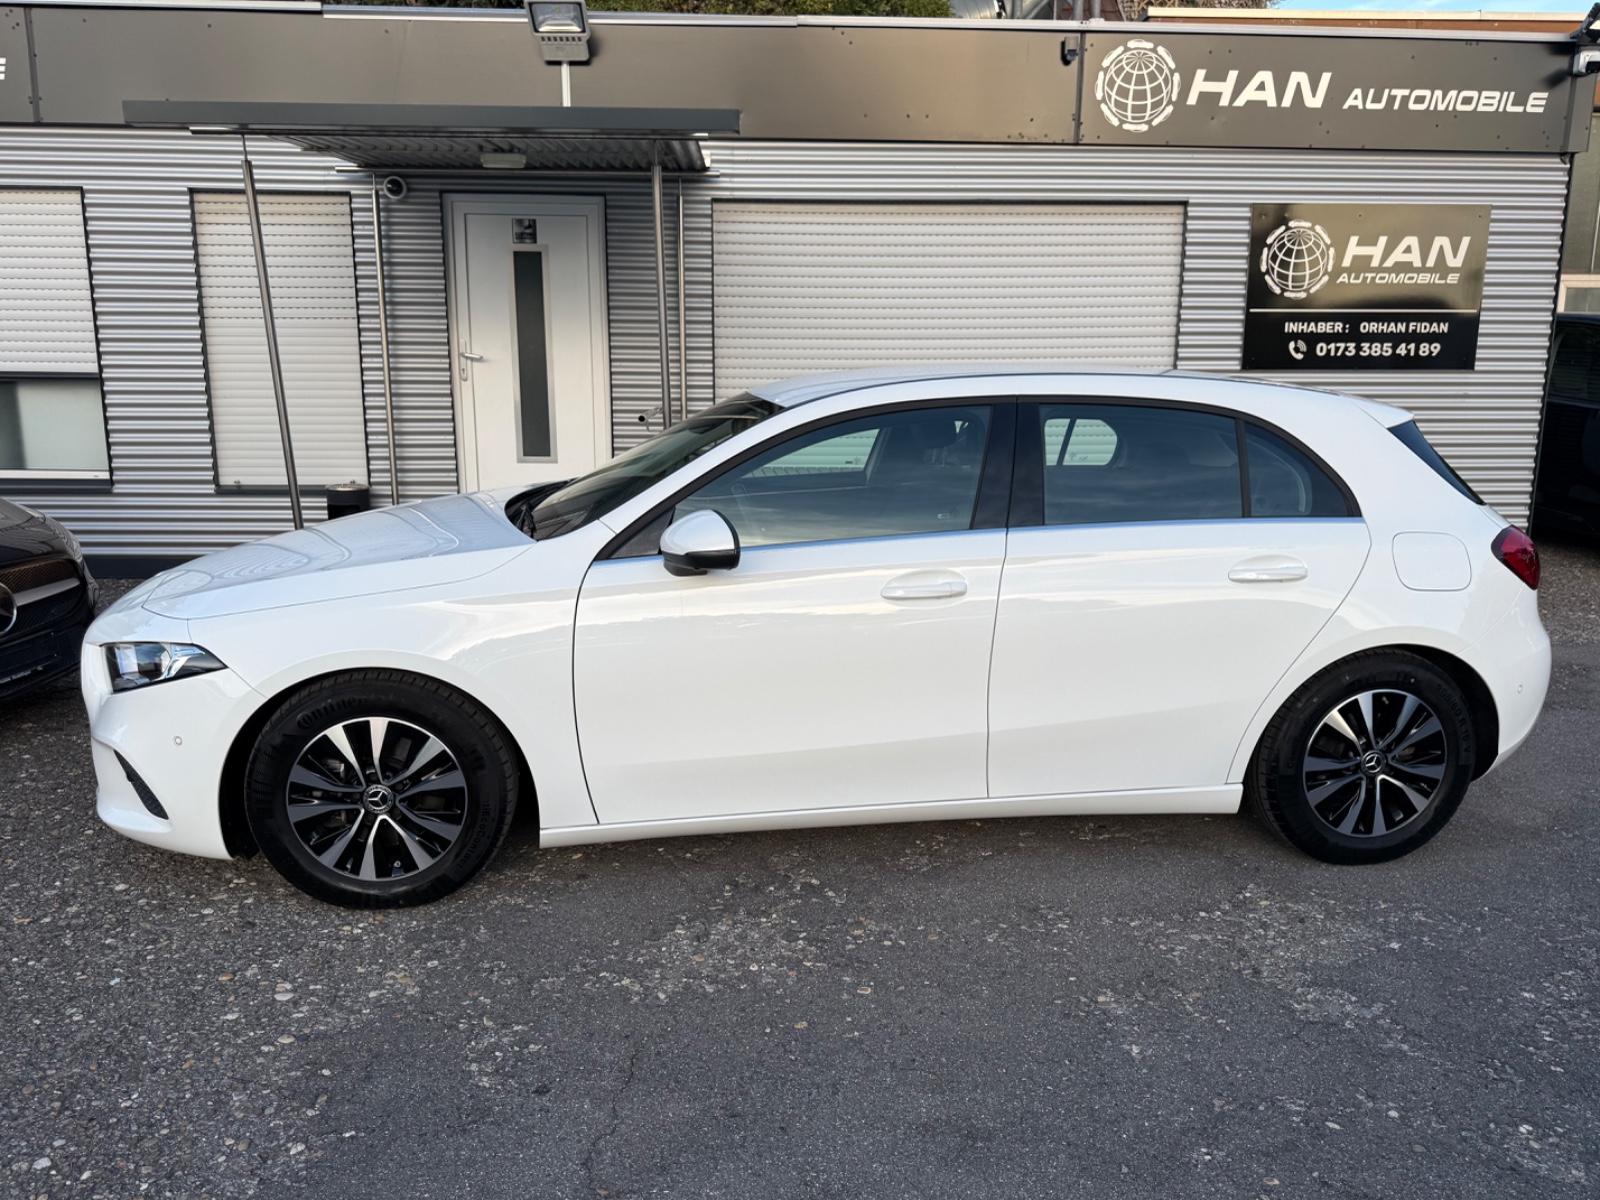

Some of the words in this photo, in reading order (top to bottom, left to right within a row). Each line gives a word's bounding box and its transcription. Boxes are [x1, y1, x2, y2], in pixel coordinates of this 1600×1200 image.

[1186, 68, 1332, 108] HAN
[1342, 87, 1549, 113] AUTOMOBILE
[1341, 235, 1472, 268] HAN
[1336, 272, 1461, 284] AUTOMOBILE
[1359, 321, 1406, 333] ORHAN
[1408, 321, 1449, 333] FIDAN
[1316, 342, 1356, 357] 0173
[1359, 342, 1393, 357] 385
